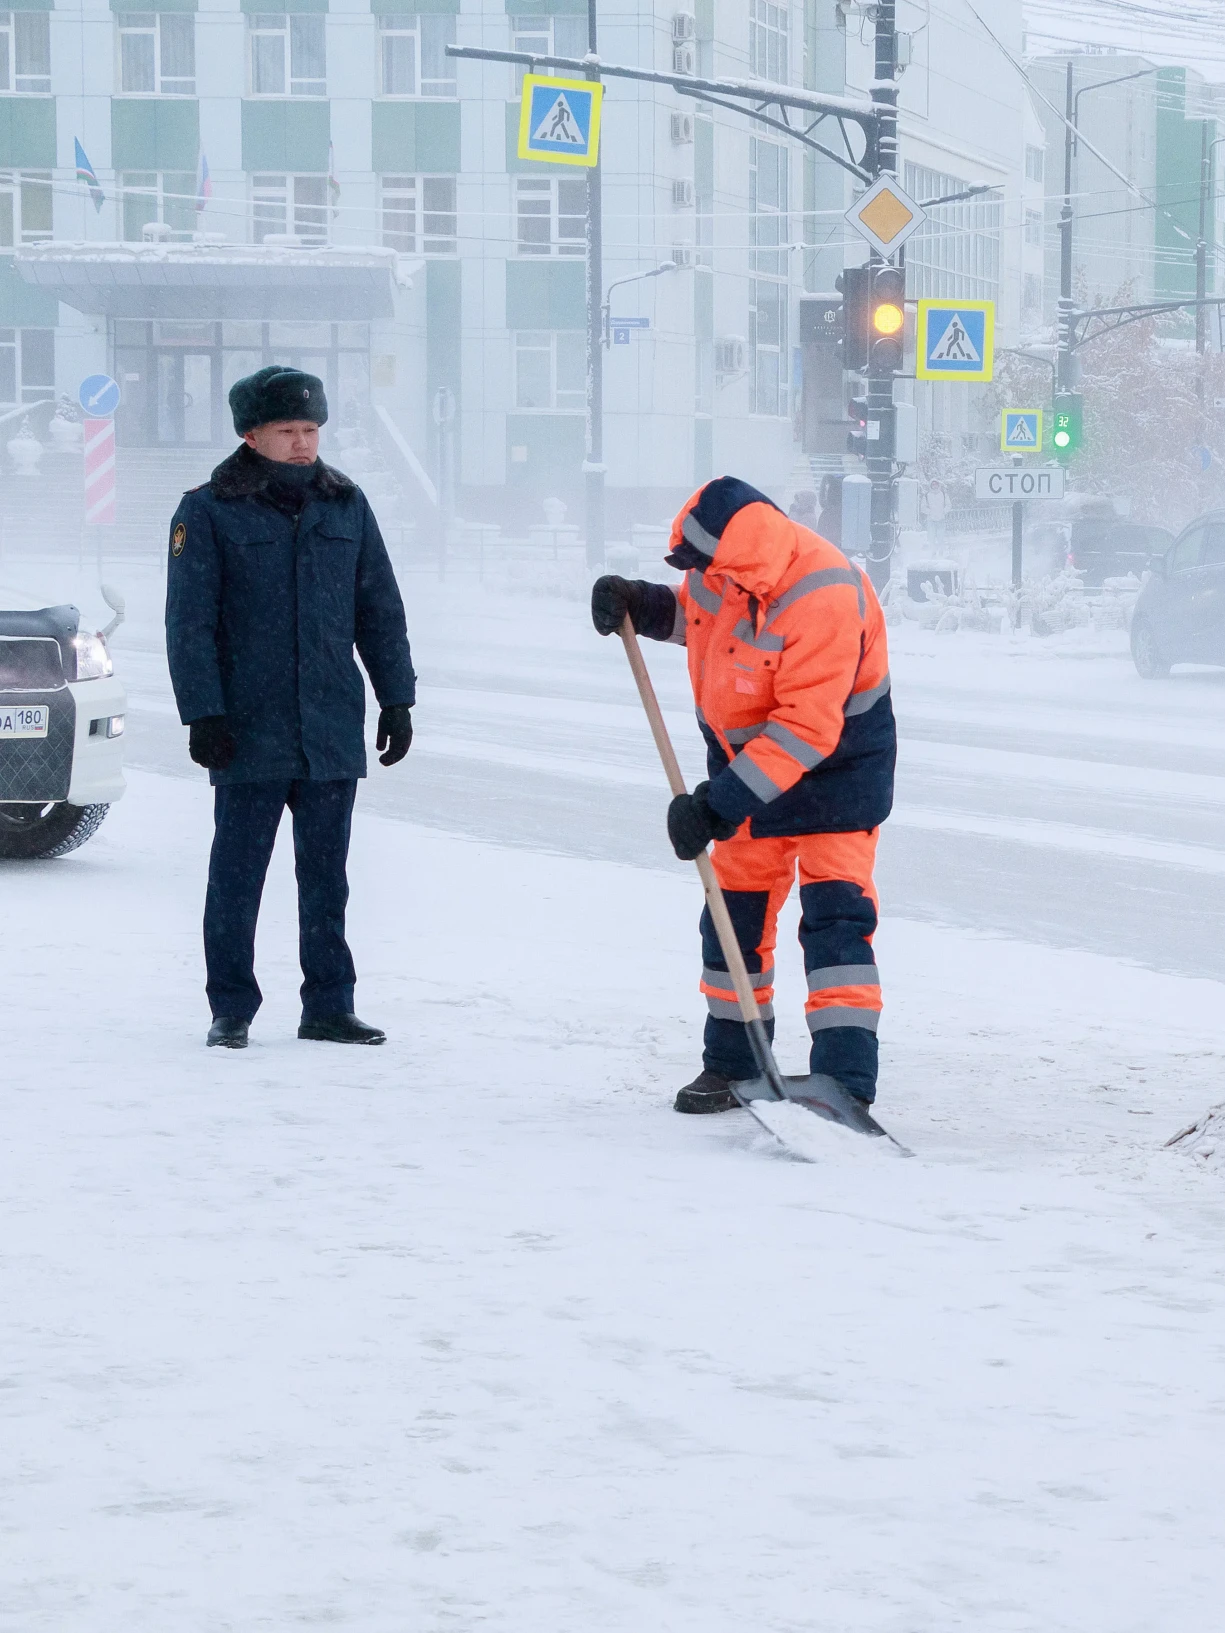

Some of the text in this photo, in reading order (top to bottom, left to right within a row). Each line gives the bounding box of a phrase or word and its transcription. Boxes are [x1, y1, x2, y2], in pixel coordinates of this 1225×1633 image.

[619, 332, 625, 341] 2
[1058, 416, 1069, 428] 32
[988, 473, 1051, 494] СТОП
[17, 710, 42, 725] 180
